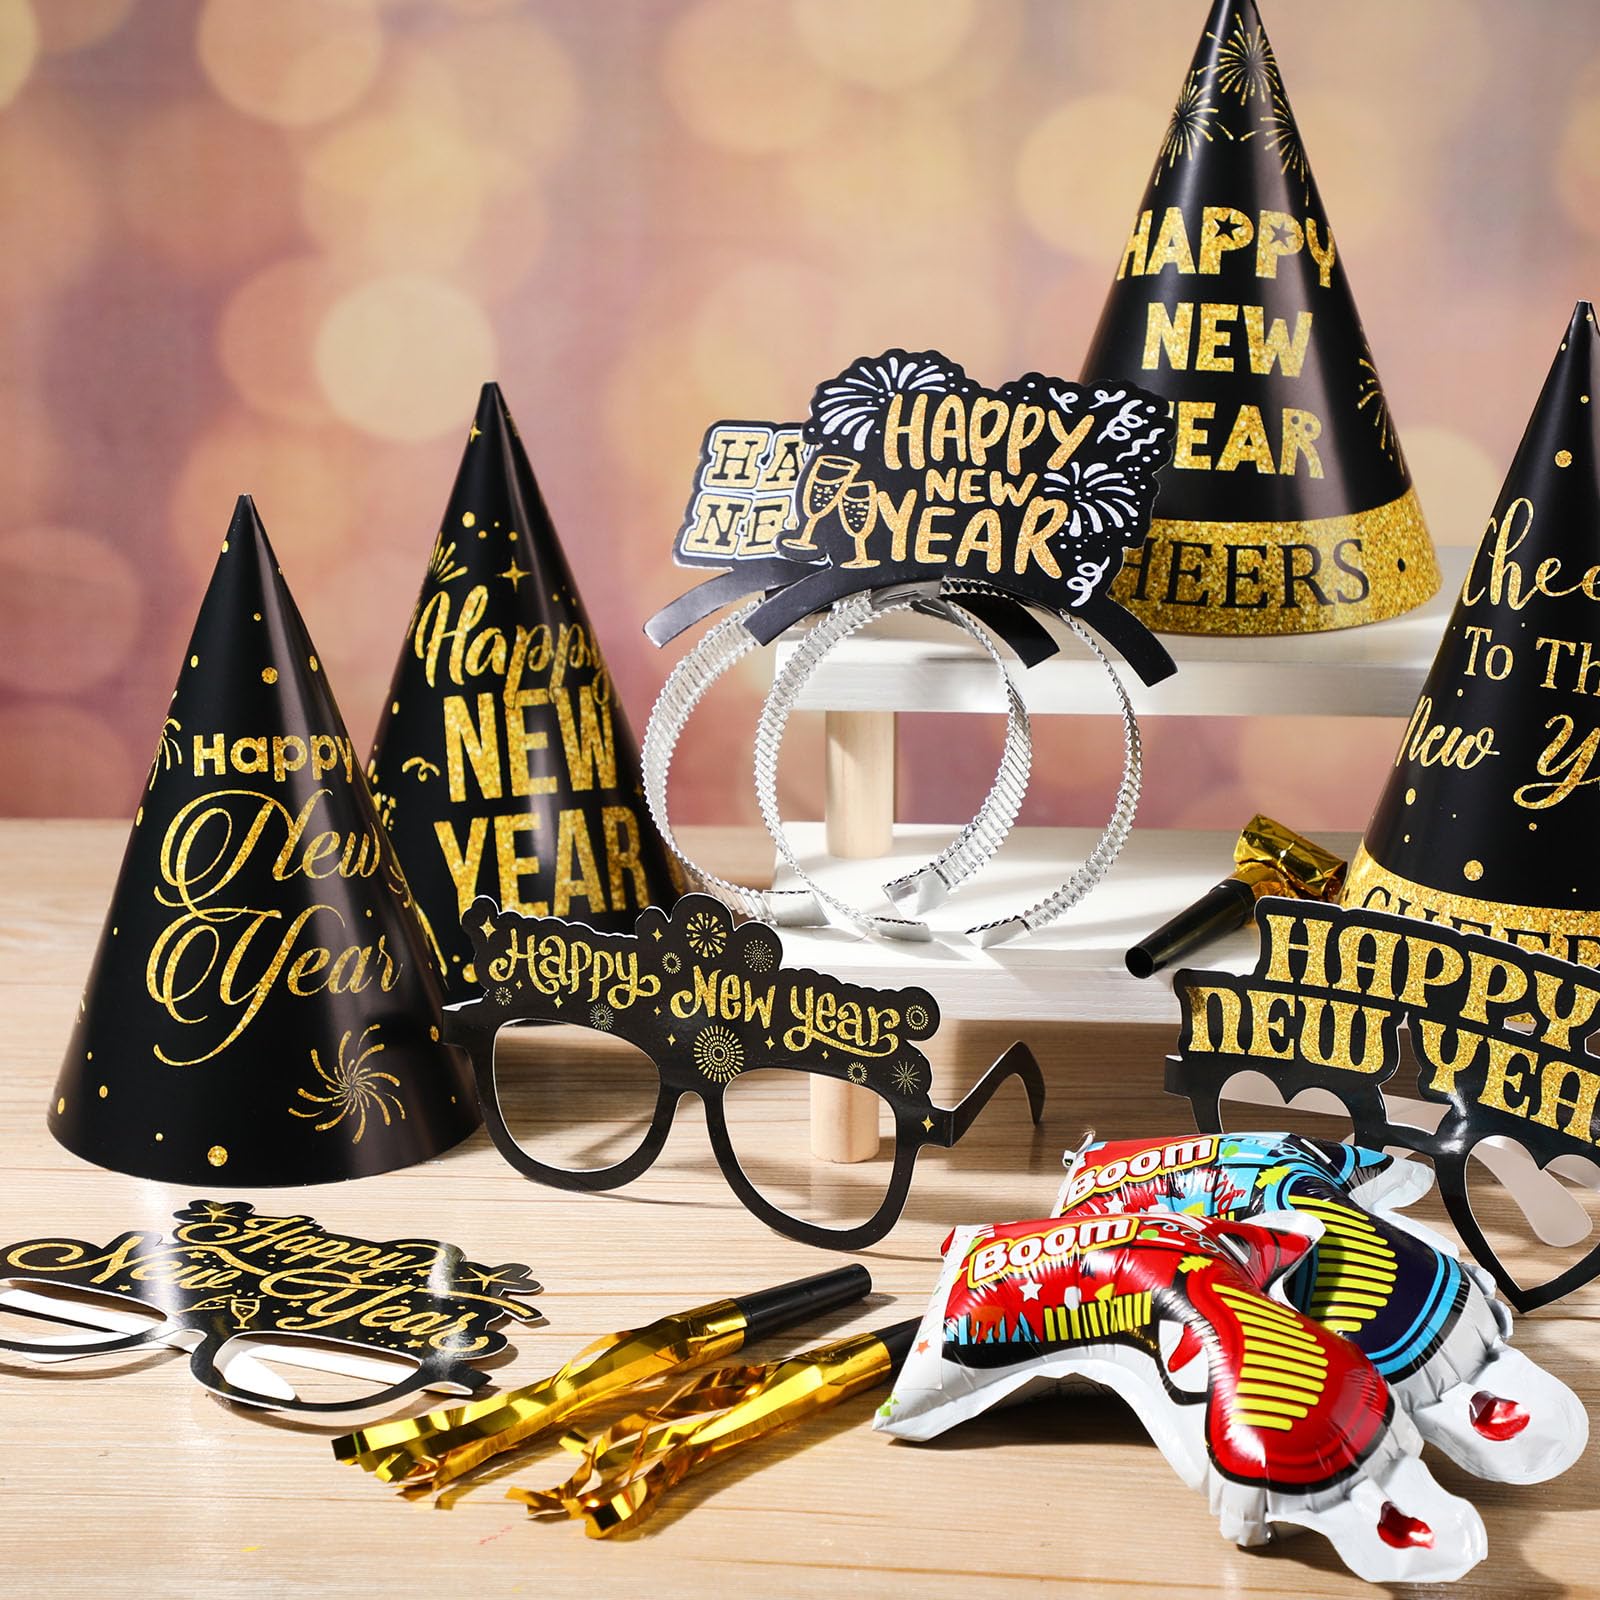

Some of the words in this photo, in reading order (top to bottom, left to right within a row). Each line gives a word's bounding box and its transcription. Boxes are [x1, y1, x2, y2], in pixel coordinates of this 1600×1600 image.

[1117, 206, 1335, 288] HAPPY
[1142, 302, 1312, 377] NEW
[884, 393, 1093, 474] HAPPY
[1168, 401, 1323, 478] EAR
[695, 504, 783, 546] NE
[926, 468, 1037, 506] NEW
[877, 490, 1068, 577] YEAR
[1124, 538, 1370, 607] HEERS
[414, 585, 610, 709] Happy
[1464, 626, 1514, 680] To
[1535, 637, 1600, 697] Th
[193, 733, 352, 783] Happy
[443, 686, 617, 802] NEW
[1396, 695, 1500, 769] New
[154, 788, 381, 922] New
[433, 806, 648, 925] YEAR
[146, 904, 403, 1066] Year
[488, 929, 661, 1009] Happy
[671, 966, 776, 1029] New
[1265, 914, 1600, 1052] HAPPY
[1186, 986, 1392, 1074] NEW
[1418, 1018, 1600, 1147] YEA
[6, 1235, 271, 1290] New
[176, 1216, 446, 1289] Happy
[259, 1267, 534, 1352] Year
